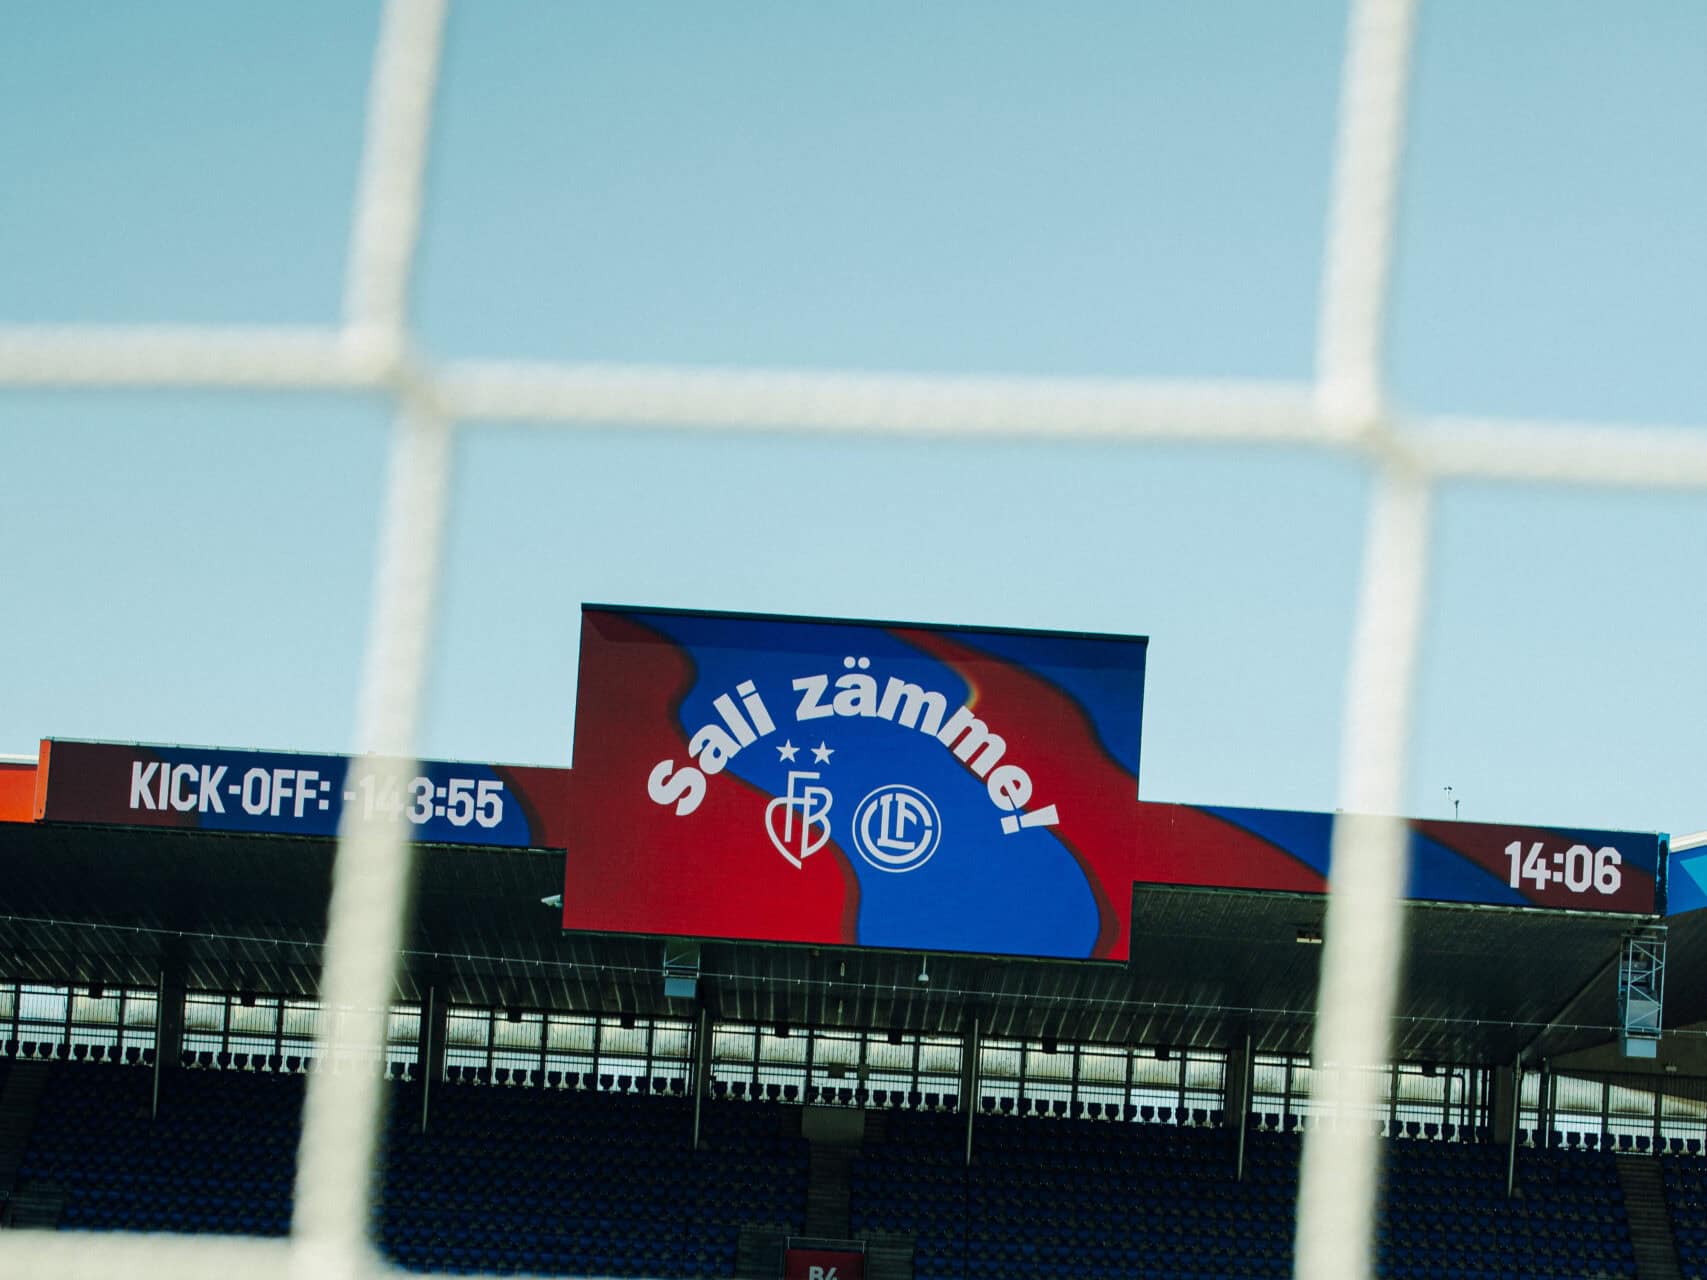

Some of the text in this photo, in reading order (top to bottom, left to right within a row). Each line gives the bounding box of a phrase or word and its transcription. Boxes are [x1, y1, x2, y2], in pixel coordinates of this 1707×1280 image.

[647, 656, 1060, 835] Sali zämme!
[129, 760, 331, 818] KICK-OFF:
[1504, 840, 1622, 895] 14:06
